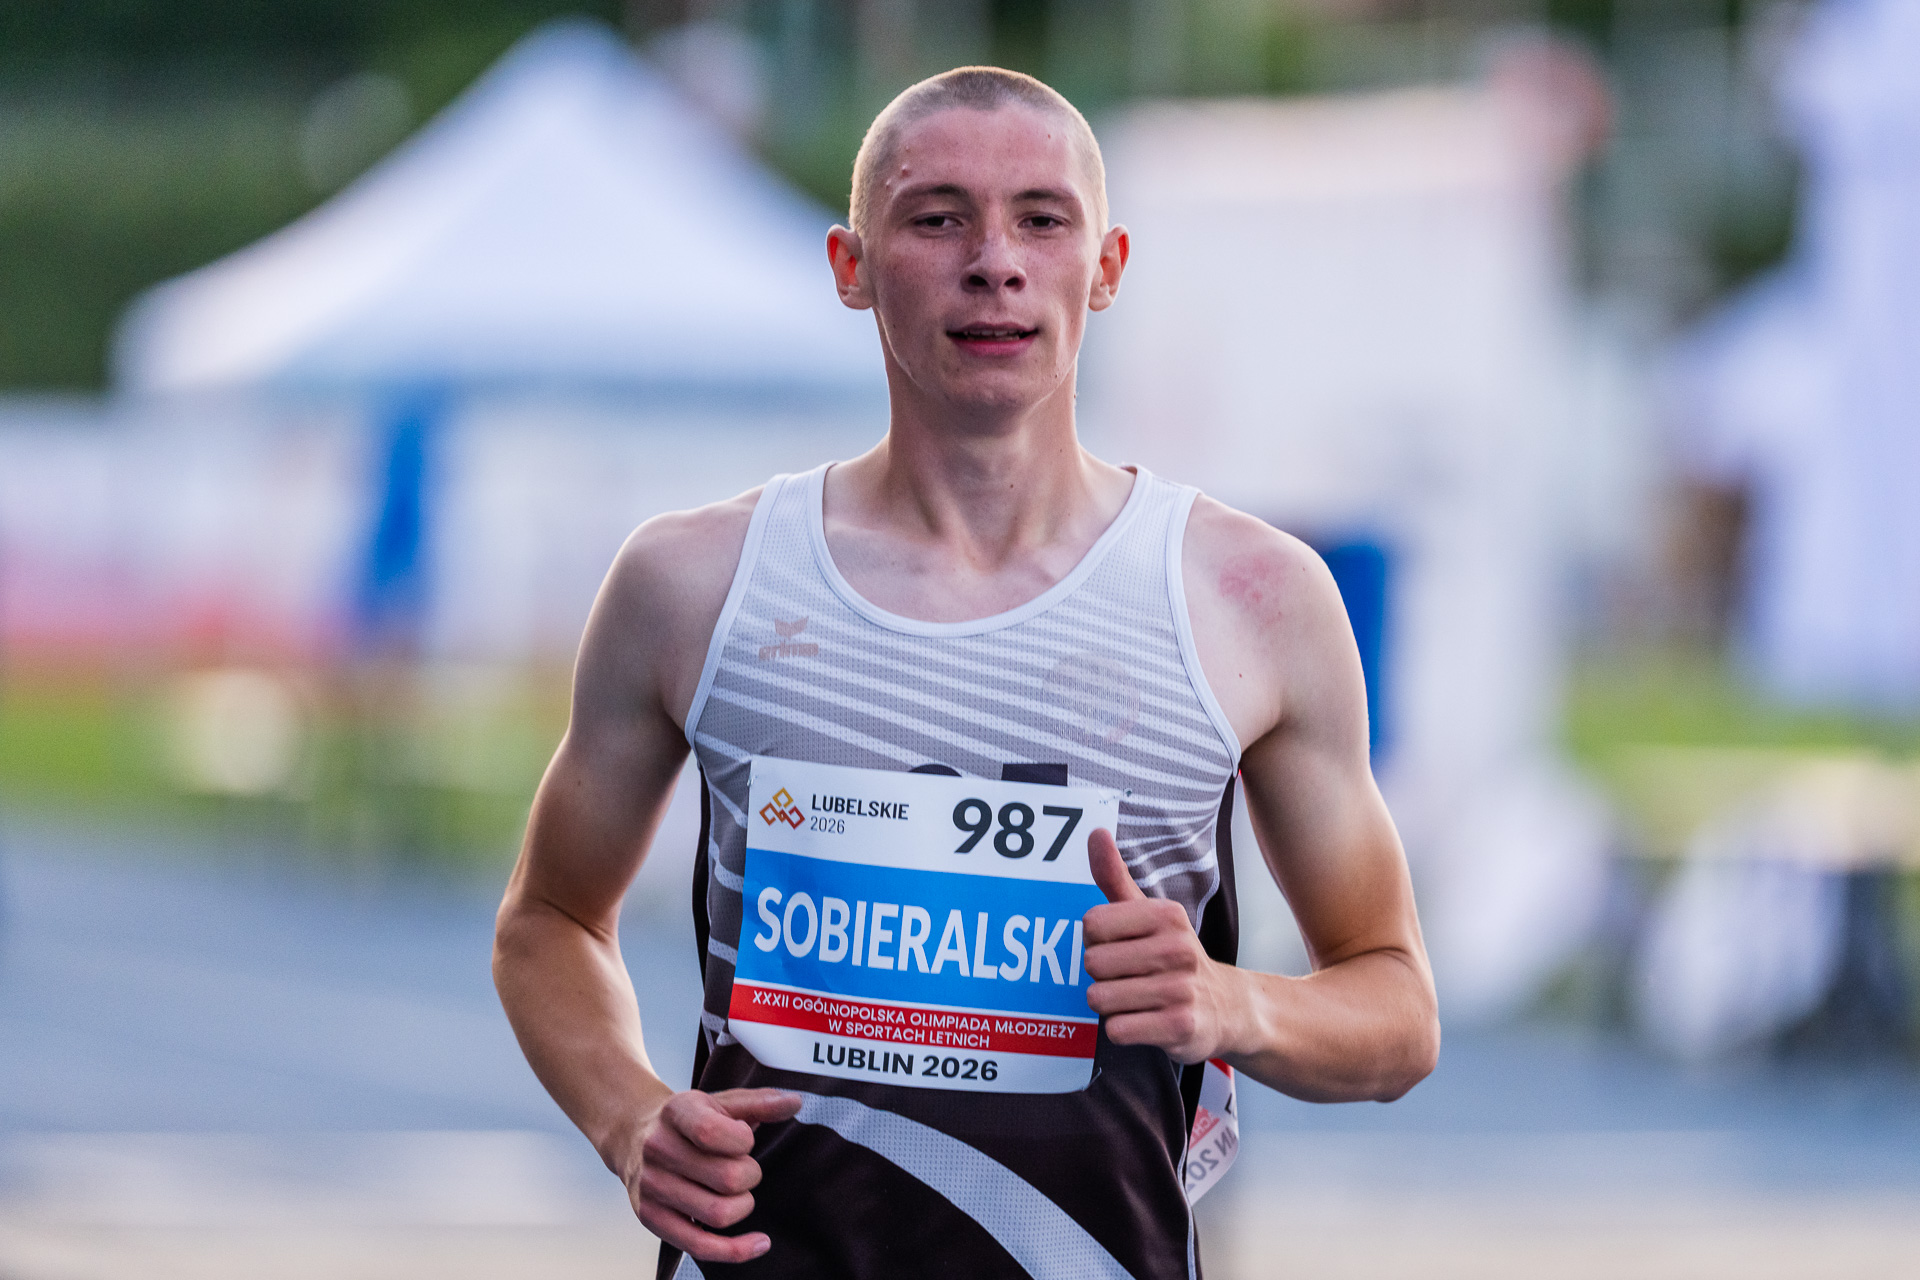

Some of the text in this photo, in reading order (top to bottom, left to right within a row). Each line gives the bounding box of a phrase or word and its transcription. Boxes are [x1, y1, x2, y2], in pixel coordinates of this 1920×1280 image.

[810, 794, 910, 821] LUBELSKIE
[810, 816, 846, 835] 2026
[952, 798, 1084, 862] 987
[754, 886, 1084, 987] SOBIERALSKI
[752, 990, 1077, 1040] XXXII OGÓLNOPOLSKA OLIMPIADA MŁODZIEŻY
[828, 1019, 990, 1049] W SPORTACH LETNICH
[813, 1042, 999, 1082] LUBLIN 2026
